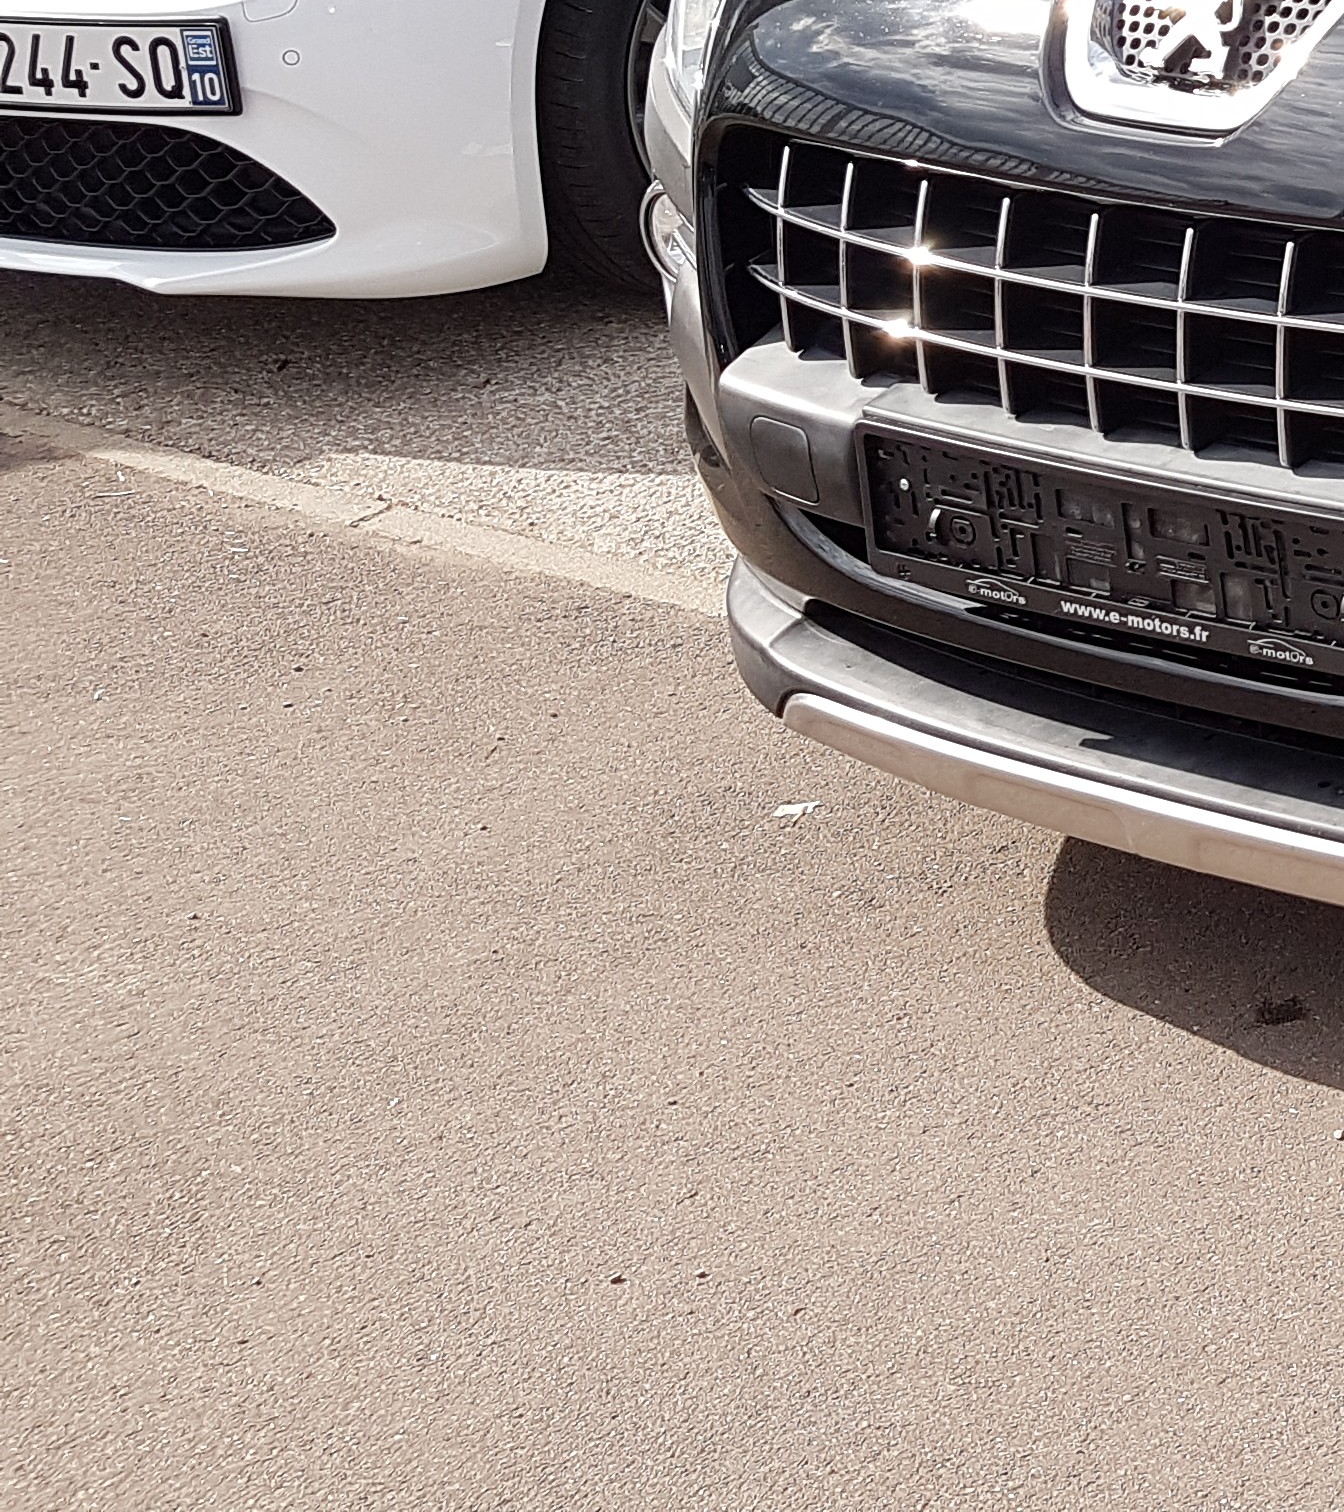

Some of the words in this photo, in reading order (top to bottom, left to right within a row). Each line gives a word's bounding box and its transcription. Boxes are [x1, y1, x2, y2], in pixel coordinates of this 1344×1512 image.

[188, 44, 213, 58] Est
[191, 72, 222, 102] 10
[1060, 600, 1210, 642] www.e-motors.fr
